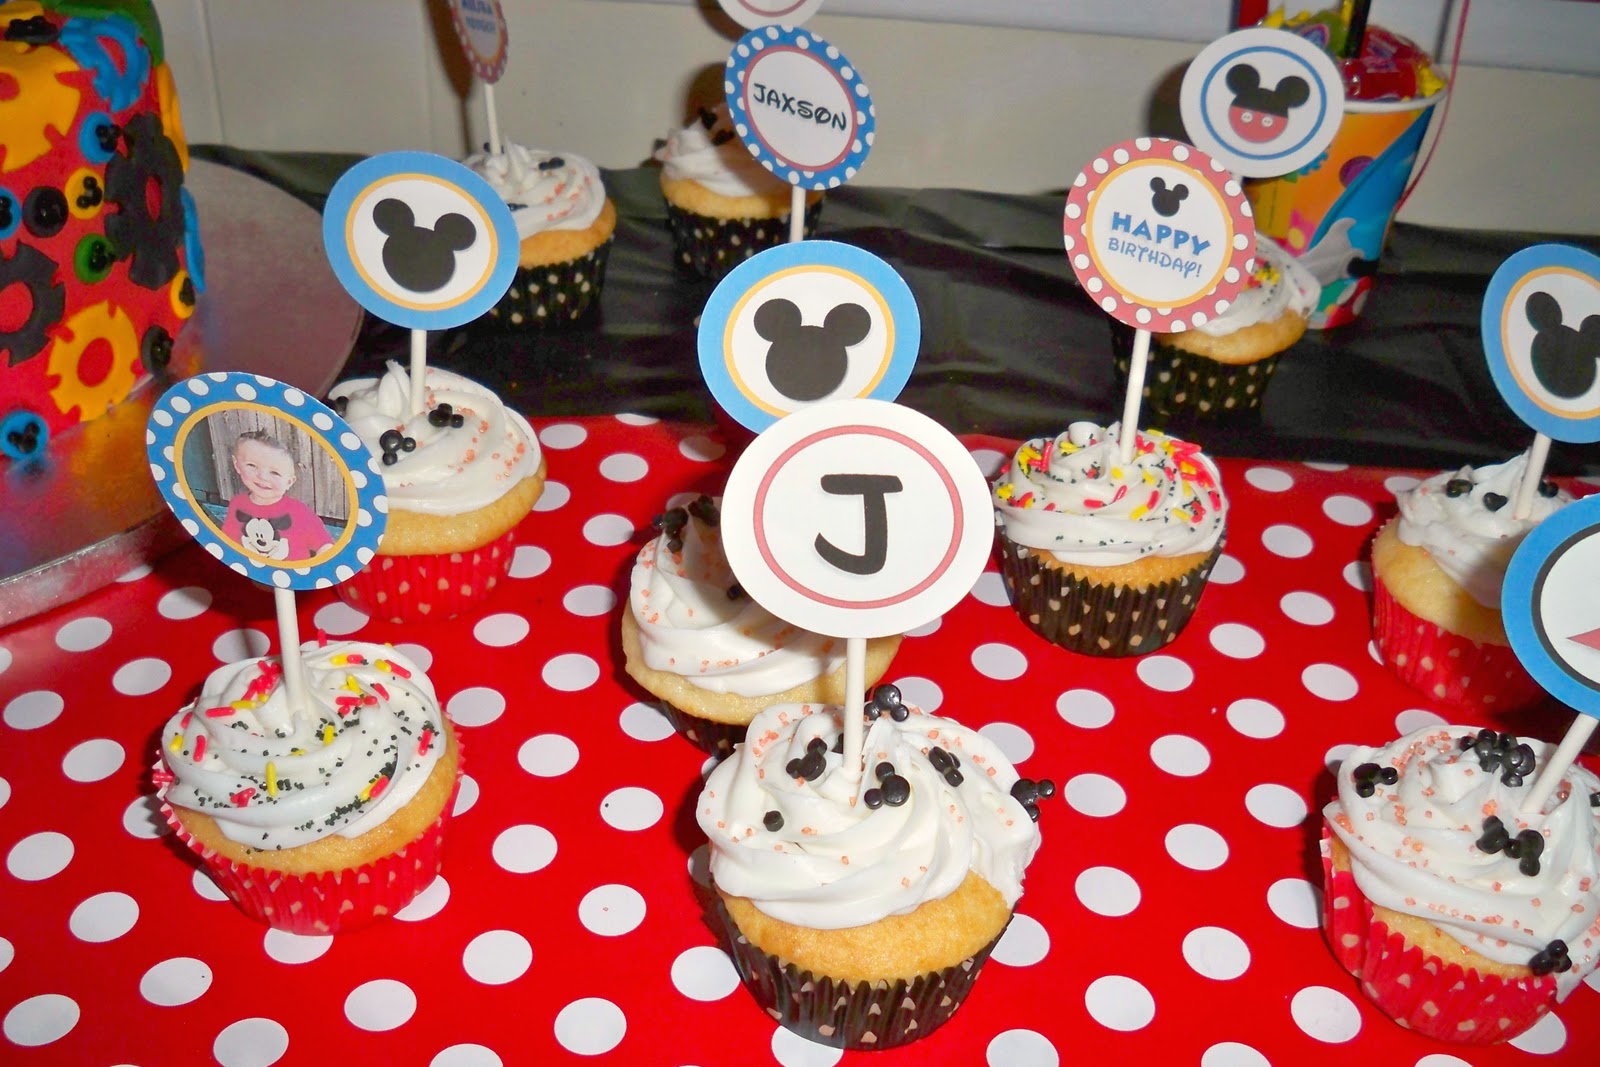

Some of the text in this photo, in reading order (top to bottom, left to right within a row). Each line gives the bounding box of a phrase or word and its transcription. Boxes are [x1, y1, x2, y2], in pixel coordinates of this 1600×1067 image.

[753, 83, 847, 131] JAXSON
[1111, 211, 1211, 256] HAPPY
[1108, 237, 1203, 279] BIRTHDAY!
[814, 473, 903, 575] J
